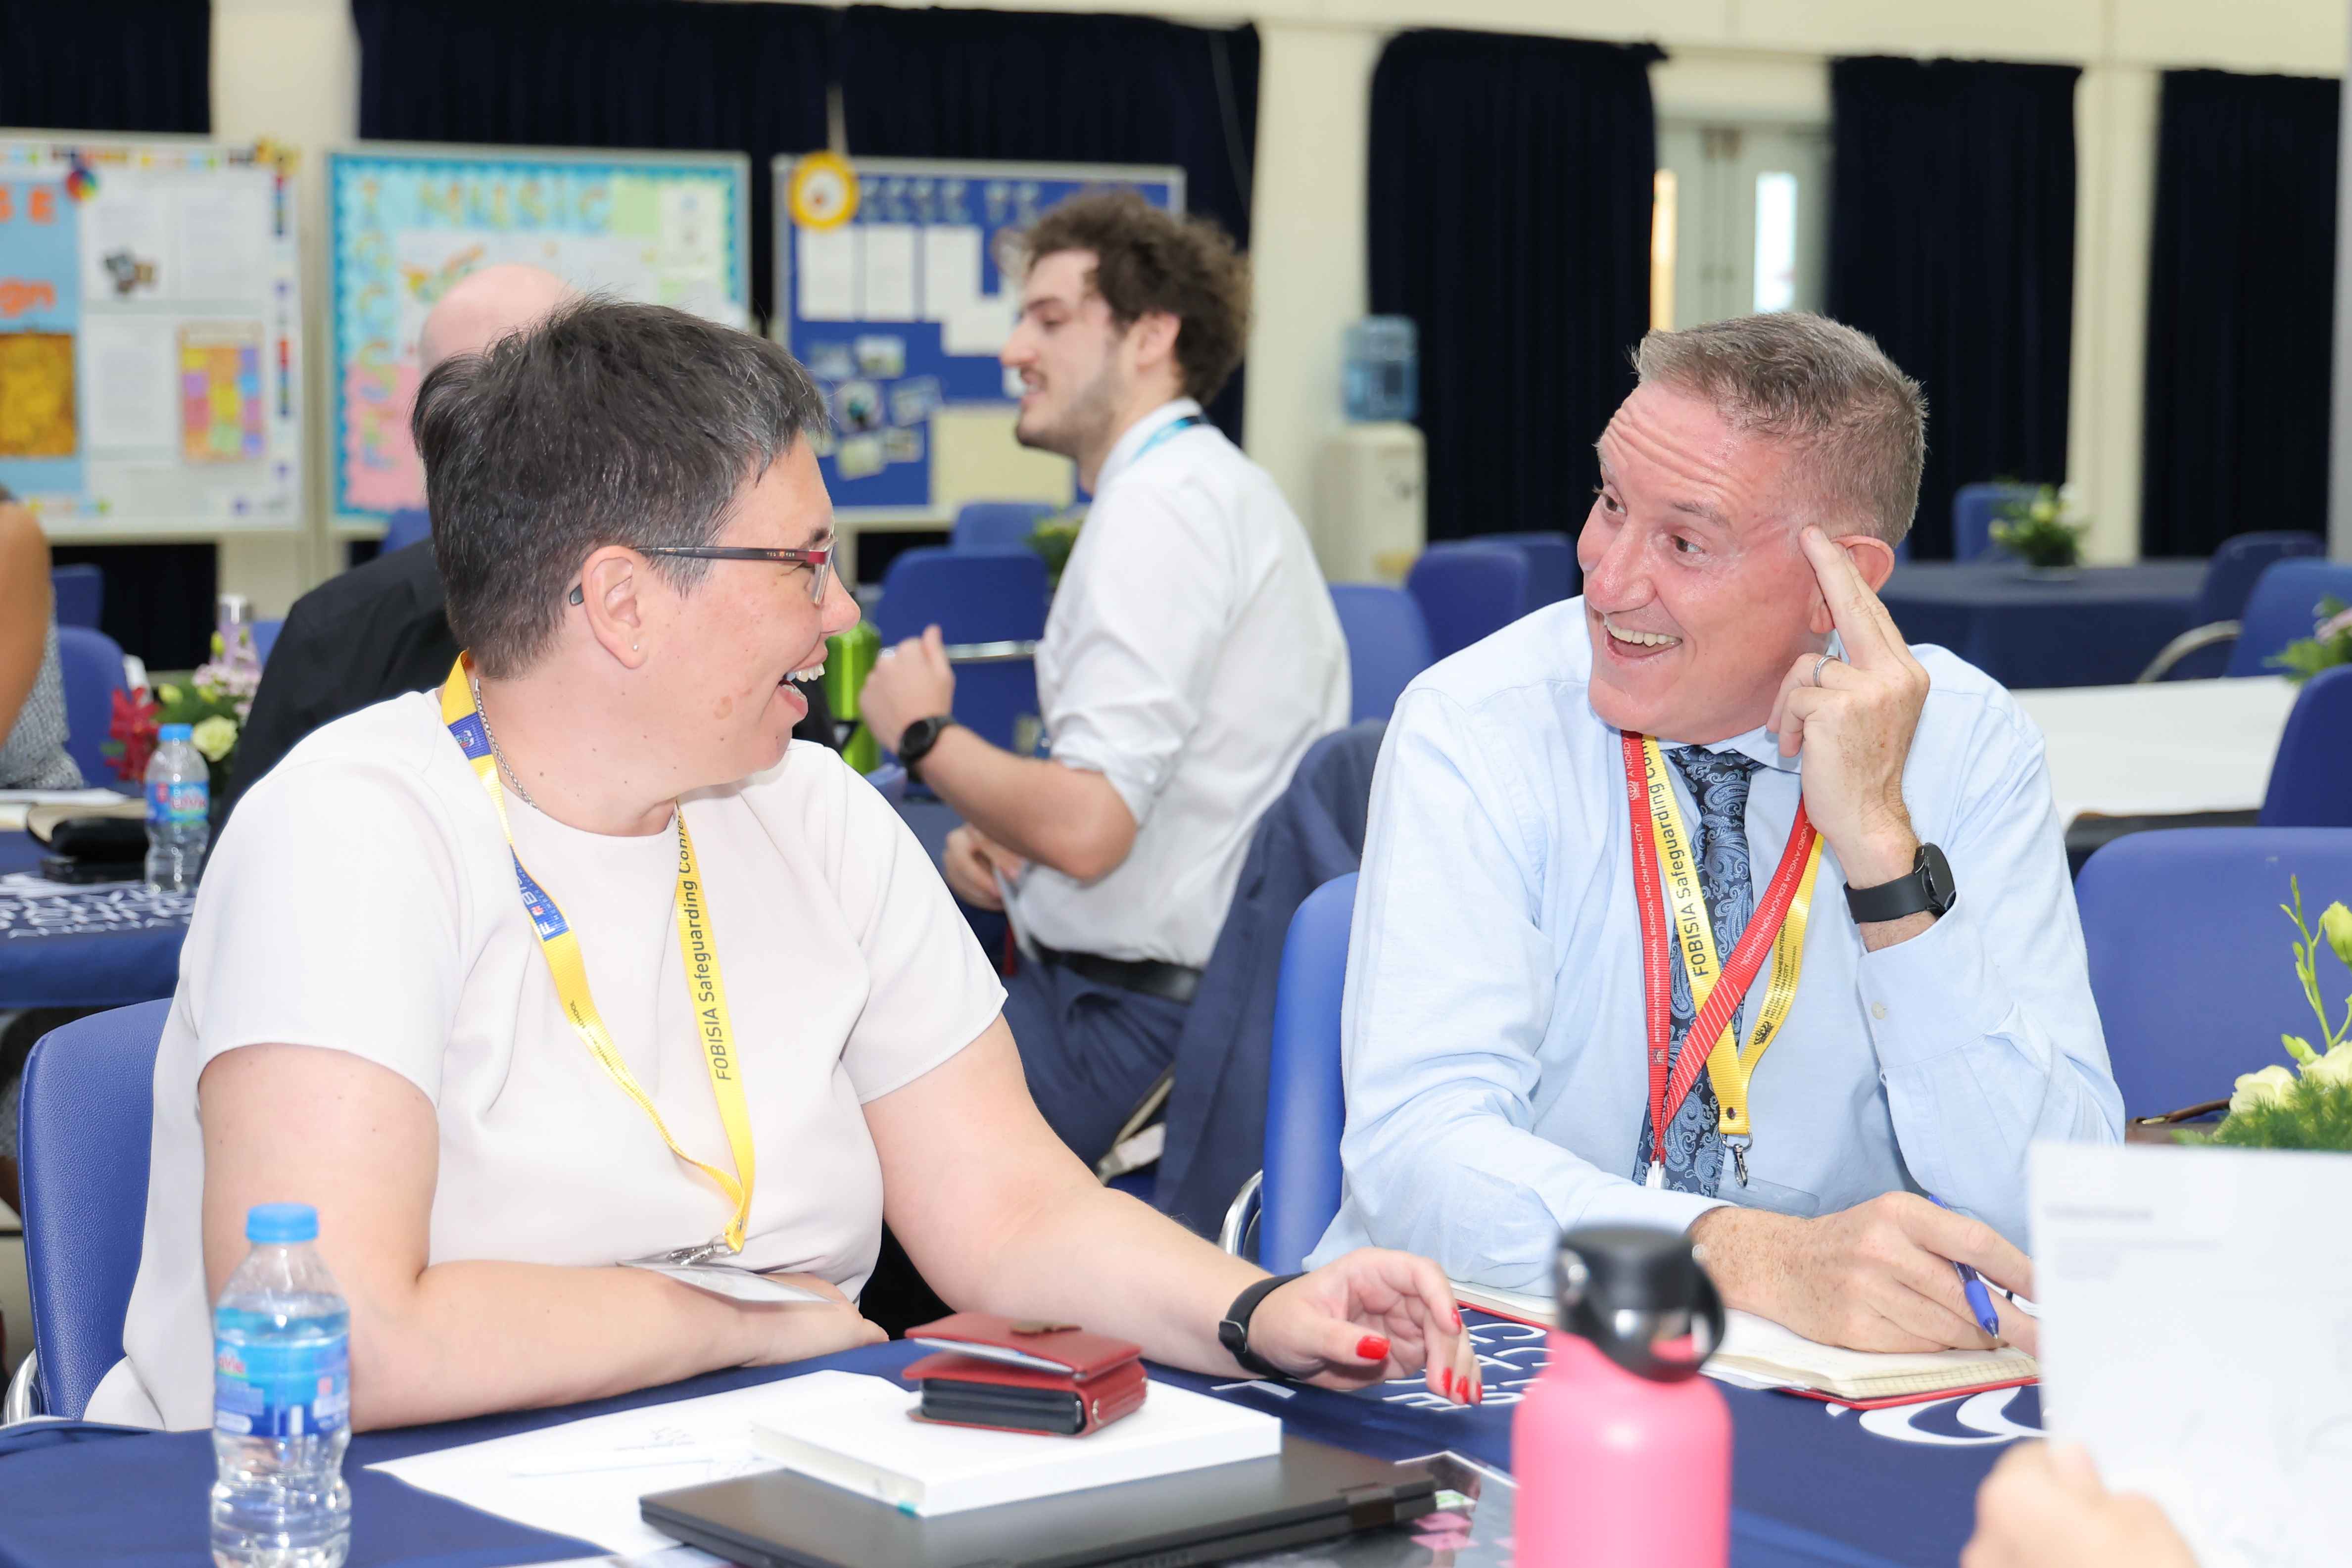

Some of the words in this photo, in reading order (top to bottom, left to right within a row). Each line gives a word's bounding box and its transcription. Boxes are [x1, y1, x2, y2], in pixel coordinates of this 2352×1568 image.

[1623, 742, 1633, 769] NORD
[1634, 823, 1643, 841] CITY
[1649, 783, 1691, 899] Safeguarding
[1797, 826, 1809, 850] NORD
[1637, 843, 1647, 867] MINH
[1784, 853, 1801, 882] ANGLIA
[1641, 868, 1650, 883] CHI
[1644, 884, 1651, 898] HO
[1647, 900, 1657, 936] SCHOOL
[1760, 883, 1788, 931] EDUCATION
[683, 880, 715, 1002] Safeguarding
[1680, 903, 1709, 977] FOBISIA
[1741, 932, 1764, 966] SCHOOL
[1774, 954, 1784, 992] VIETNAMESE
[702, 1007, 732, 1081] FOBISIA
